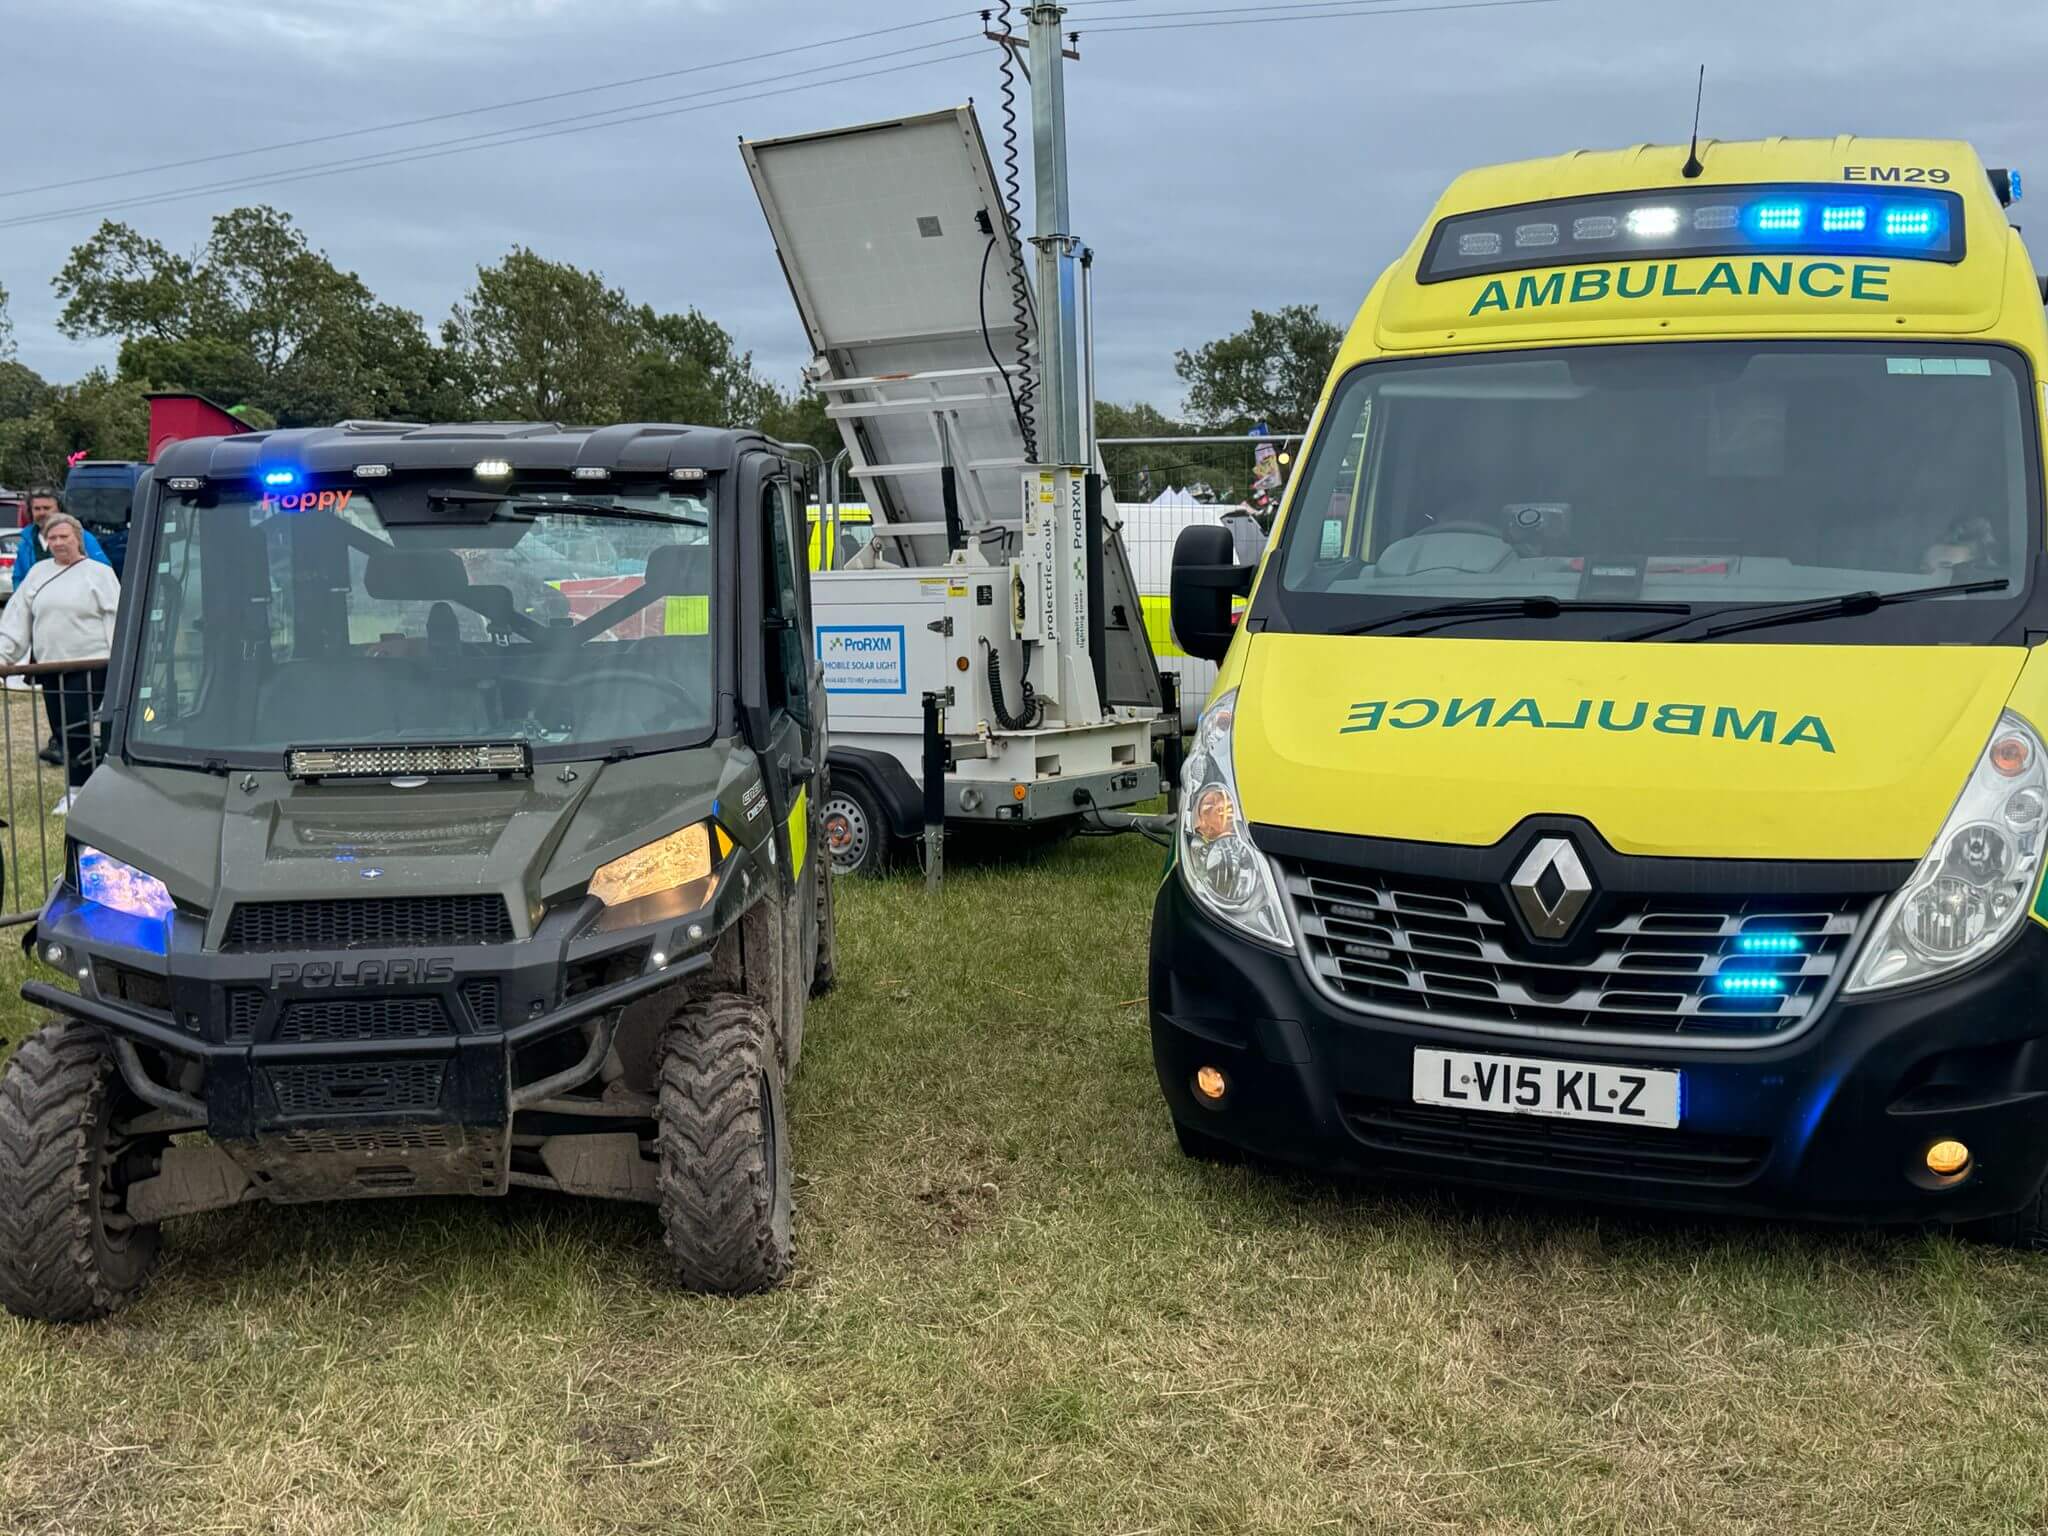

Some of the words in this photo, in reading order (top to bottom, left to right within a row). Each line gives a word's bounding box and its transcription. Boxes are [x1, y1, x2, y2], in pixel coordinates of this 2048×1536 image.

[1843, 166, 1951, 184] EM29
[1468, 262, 1891, 316] AMBULANCE
[262, 489, 353, 512] Poppy
[1072, 480, 1082, 550] ProRXM
[1042, 519, 1056, 640] prolectric.co.uk
[844, 637, 892, 652] ProRXM
[825, 661, 850, 670] MOBILE
[851, 661, 875, 670] SOLAR
[876, 661, 897, 670] LIGHT
[270, 957, 455, 989] POLARIS
[1443, 1059, 1541, 1107] LV15
[1556, 1069, 1646, 1117] KLZ
